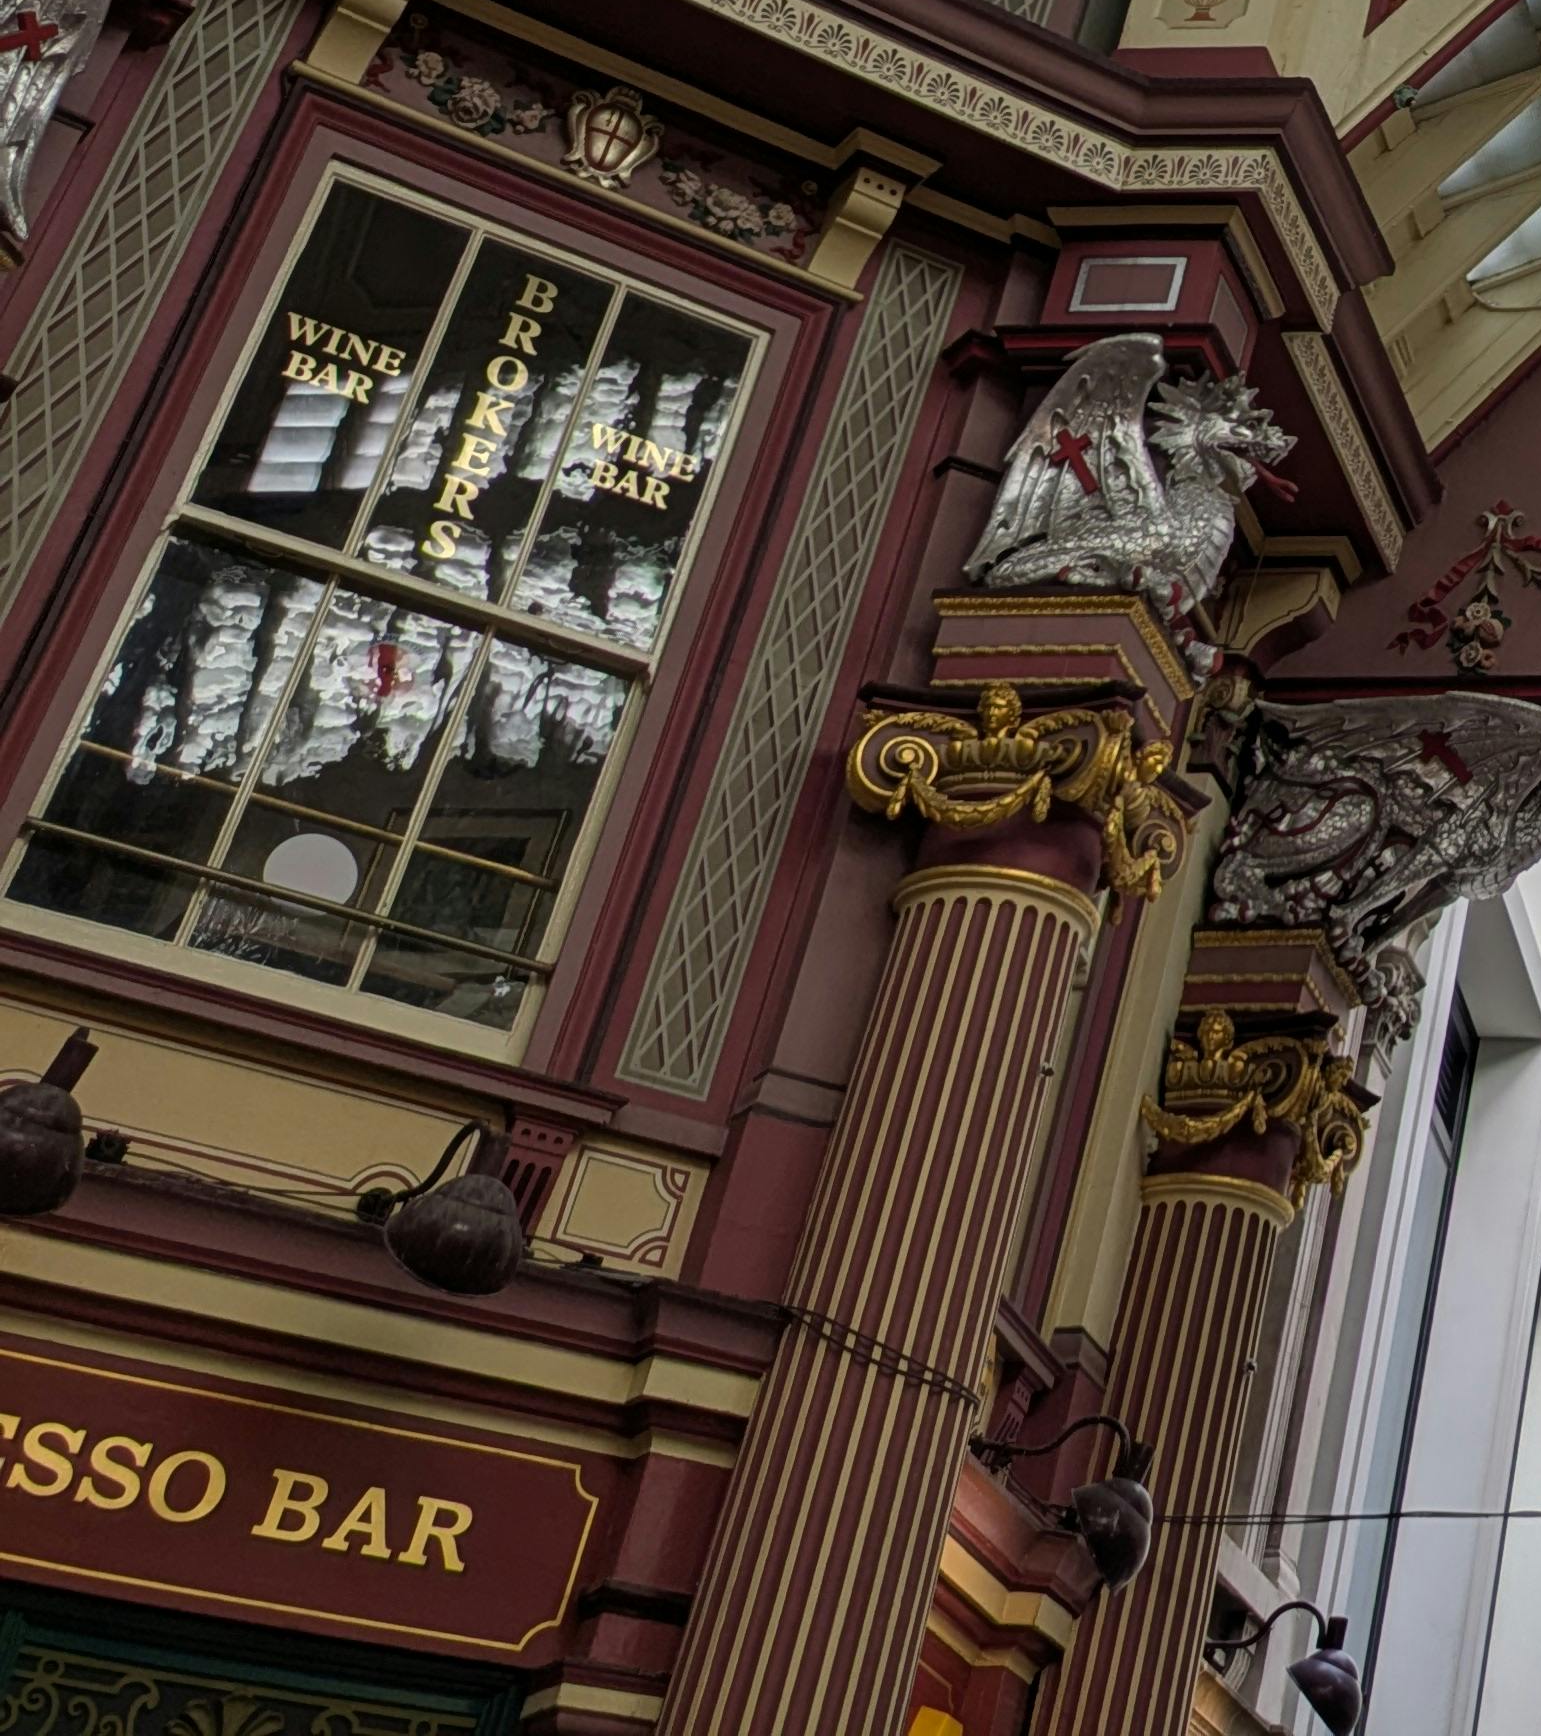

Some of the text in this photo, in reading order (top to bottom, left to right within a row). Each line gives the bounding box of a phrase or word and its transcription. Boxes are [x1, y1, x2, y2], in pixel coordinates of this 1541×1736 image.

[286, 311, 407, 377] WINE
[281, 350, 374, 404] BAR
[421, 274, 559, 560] BROKERS
[590, 422, 696, 481] WINE
[590, 460, 671, 509] BAR
[250, 1468, 473, 1571] BAR
